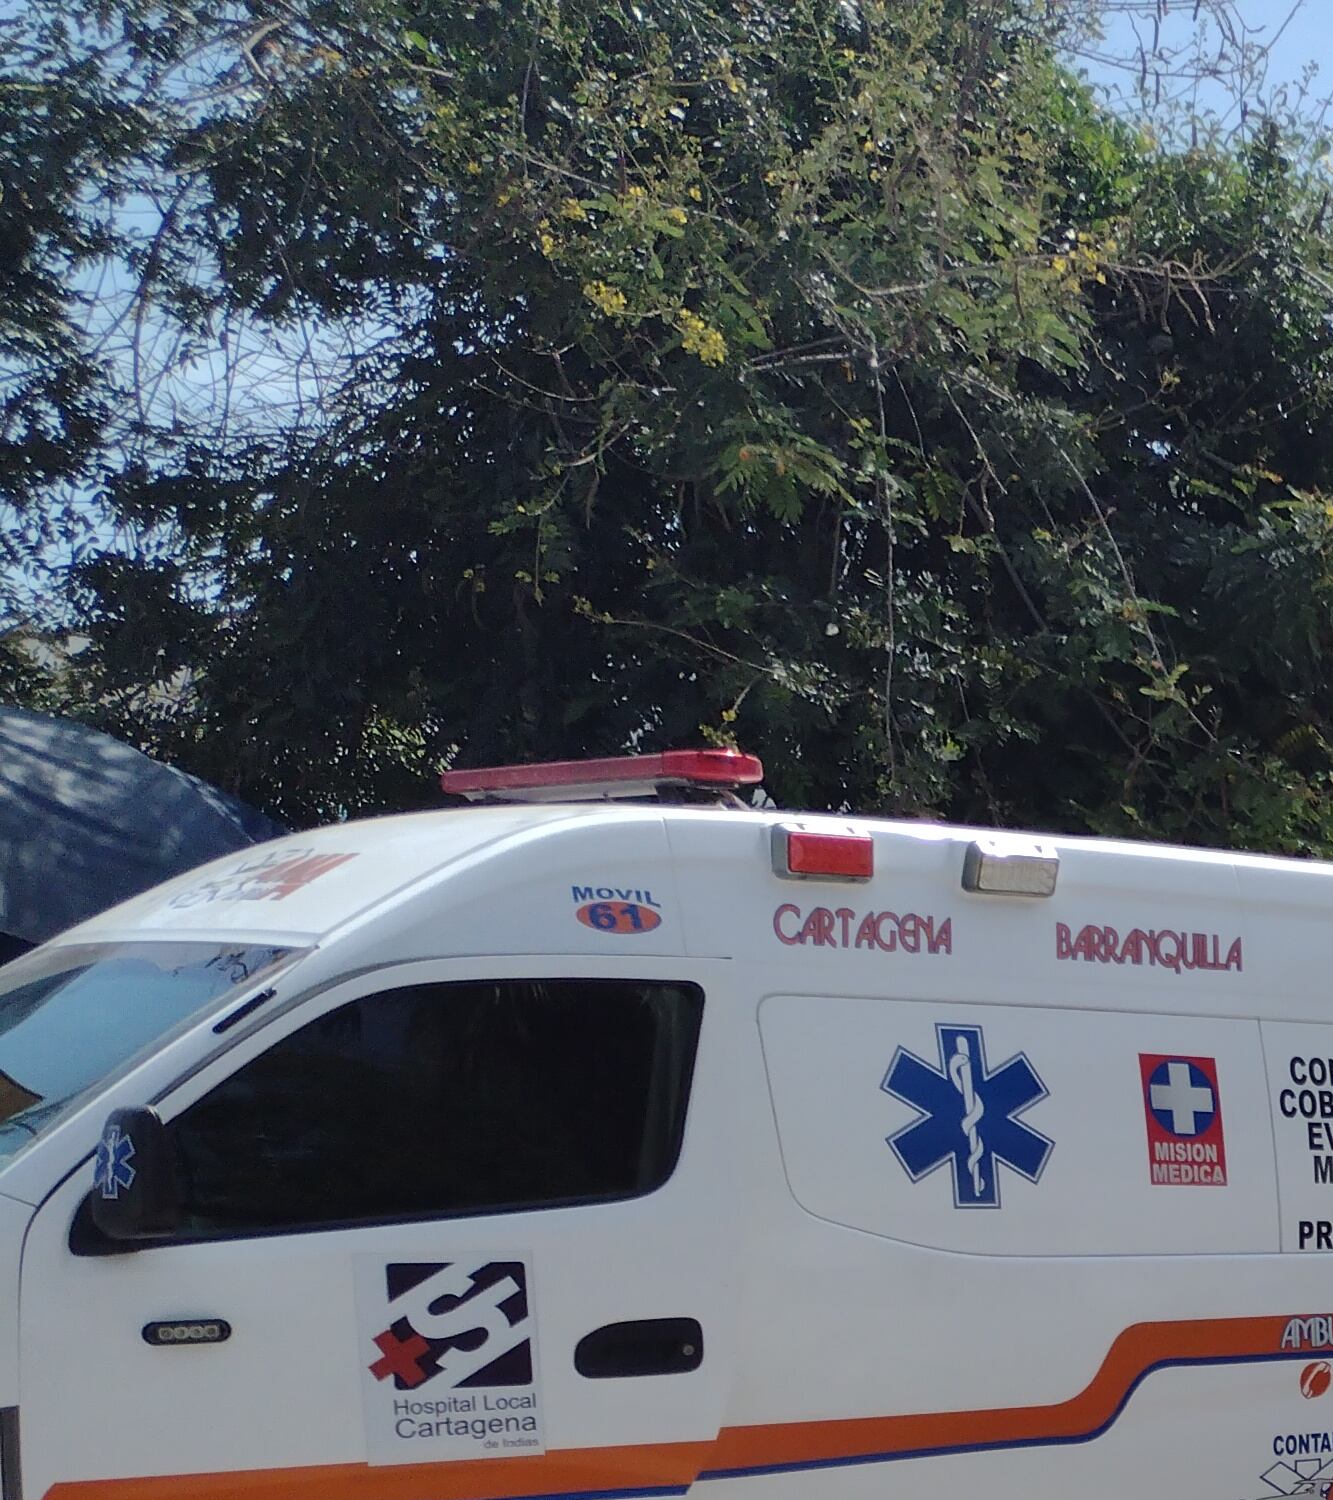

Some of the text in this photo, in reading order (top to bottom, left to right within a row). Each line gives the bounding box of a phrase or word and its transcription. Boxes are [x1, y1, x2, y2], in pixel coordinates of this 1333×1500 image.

[571, 885, 661, 908] MOVIL
[589, 902, 643, 929] 61
[773, 903, 952, 955] CARTAGENA
[1056, 922, 1243, 974] BARRANQUILLA
[1154, 1141, 1218, 1164] MISION
[1152, 1163, 1225, 1185] MEDICA
[393, 1393, 537, 1417] Hospital Local
[394, 1415, 537, 1439] Cartagena
[483, 1438, 499, 1449] de
